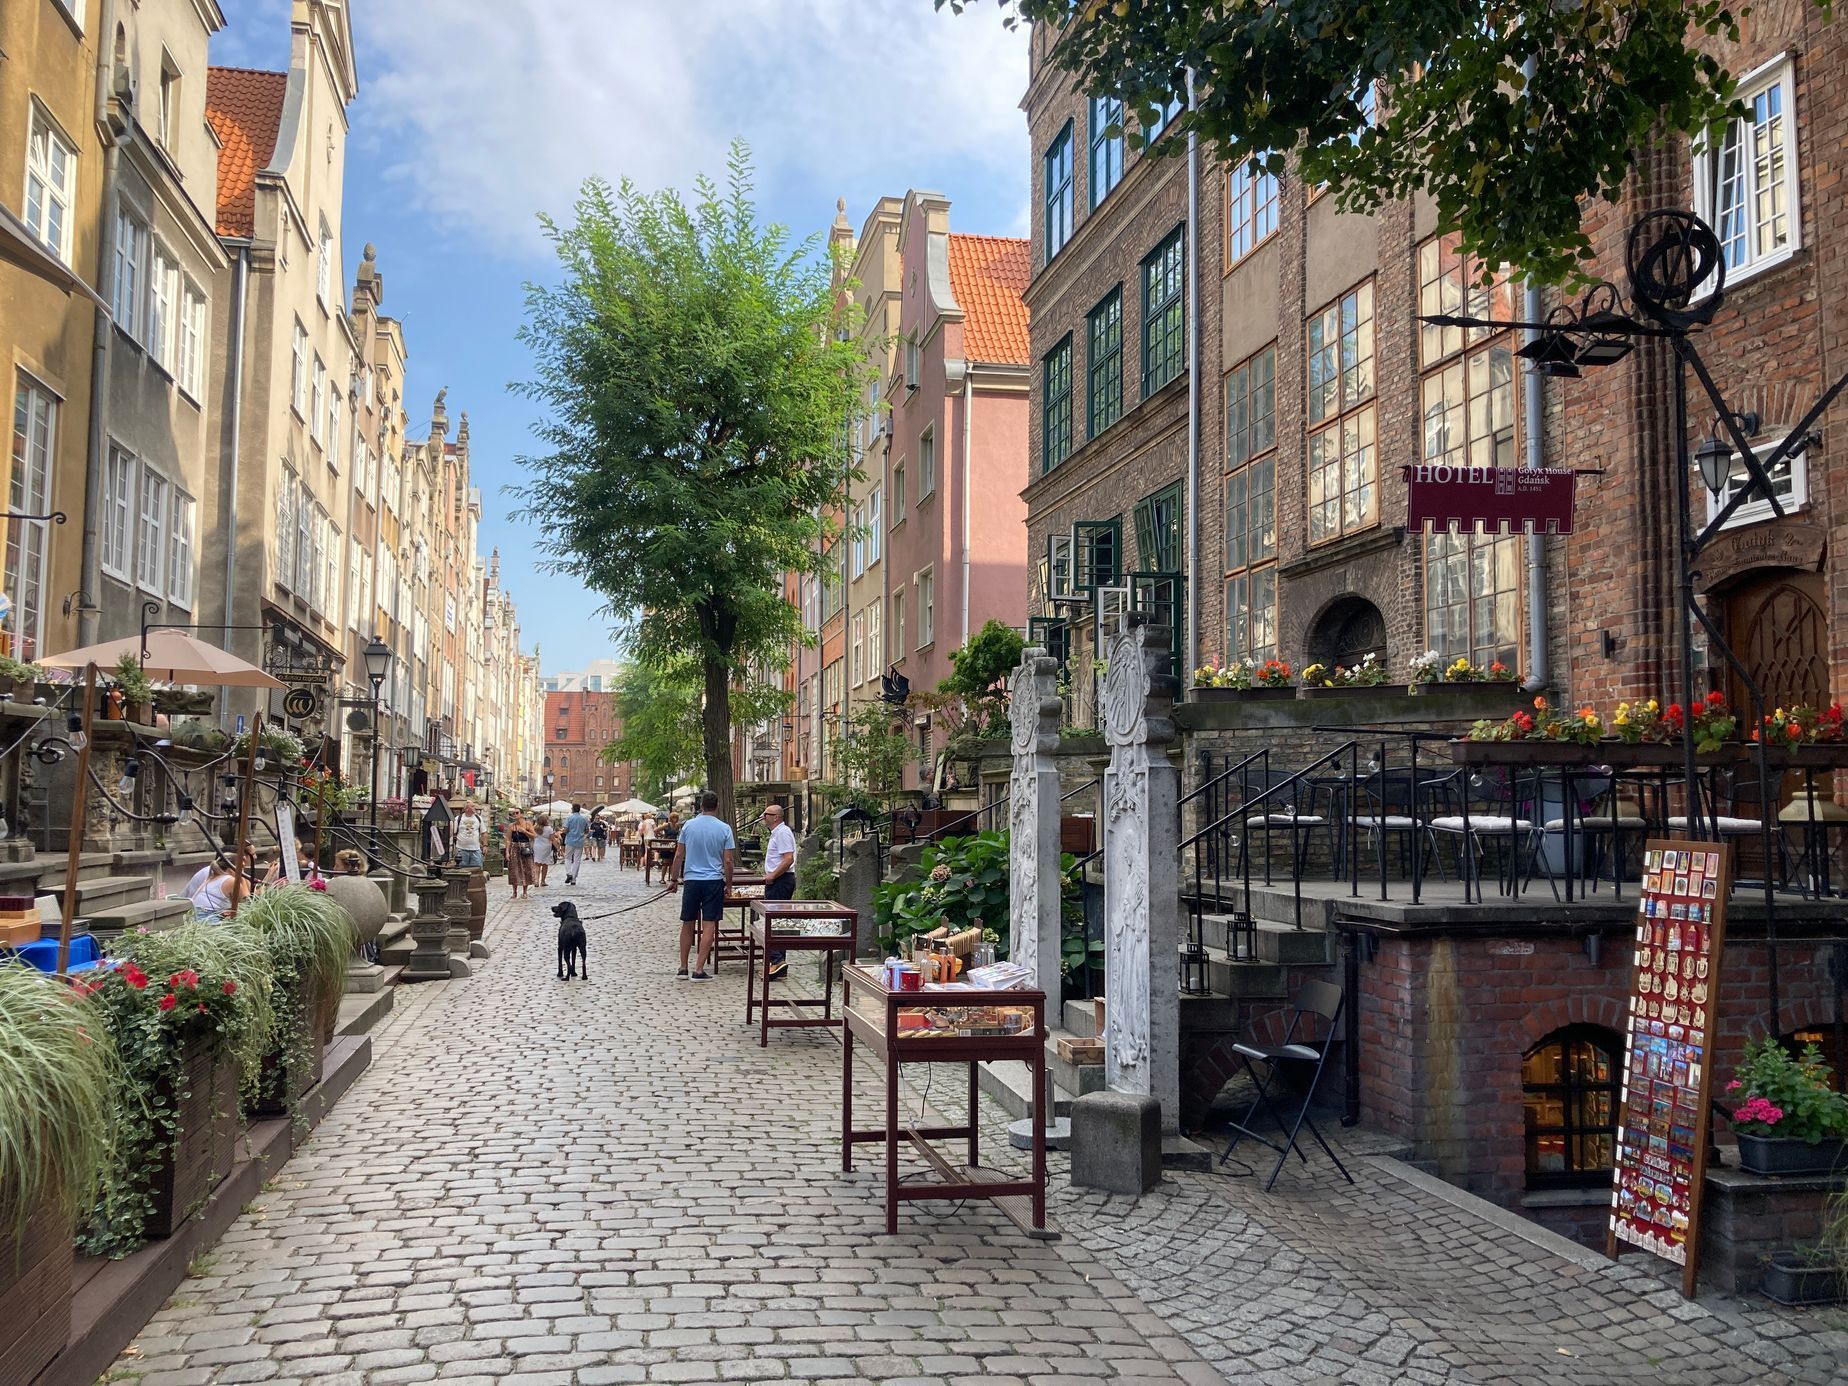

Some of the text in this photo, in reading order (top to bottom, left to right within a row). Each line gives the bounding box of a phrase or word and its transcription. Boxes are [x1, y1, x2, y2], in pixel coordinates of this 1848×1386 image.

[1415, 465, 1494, 484] HOTEL
[1517, 467, 1572, 477] Gotyk House
[1517, 475, 1550, 485] Gdańsk
